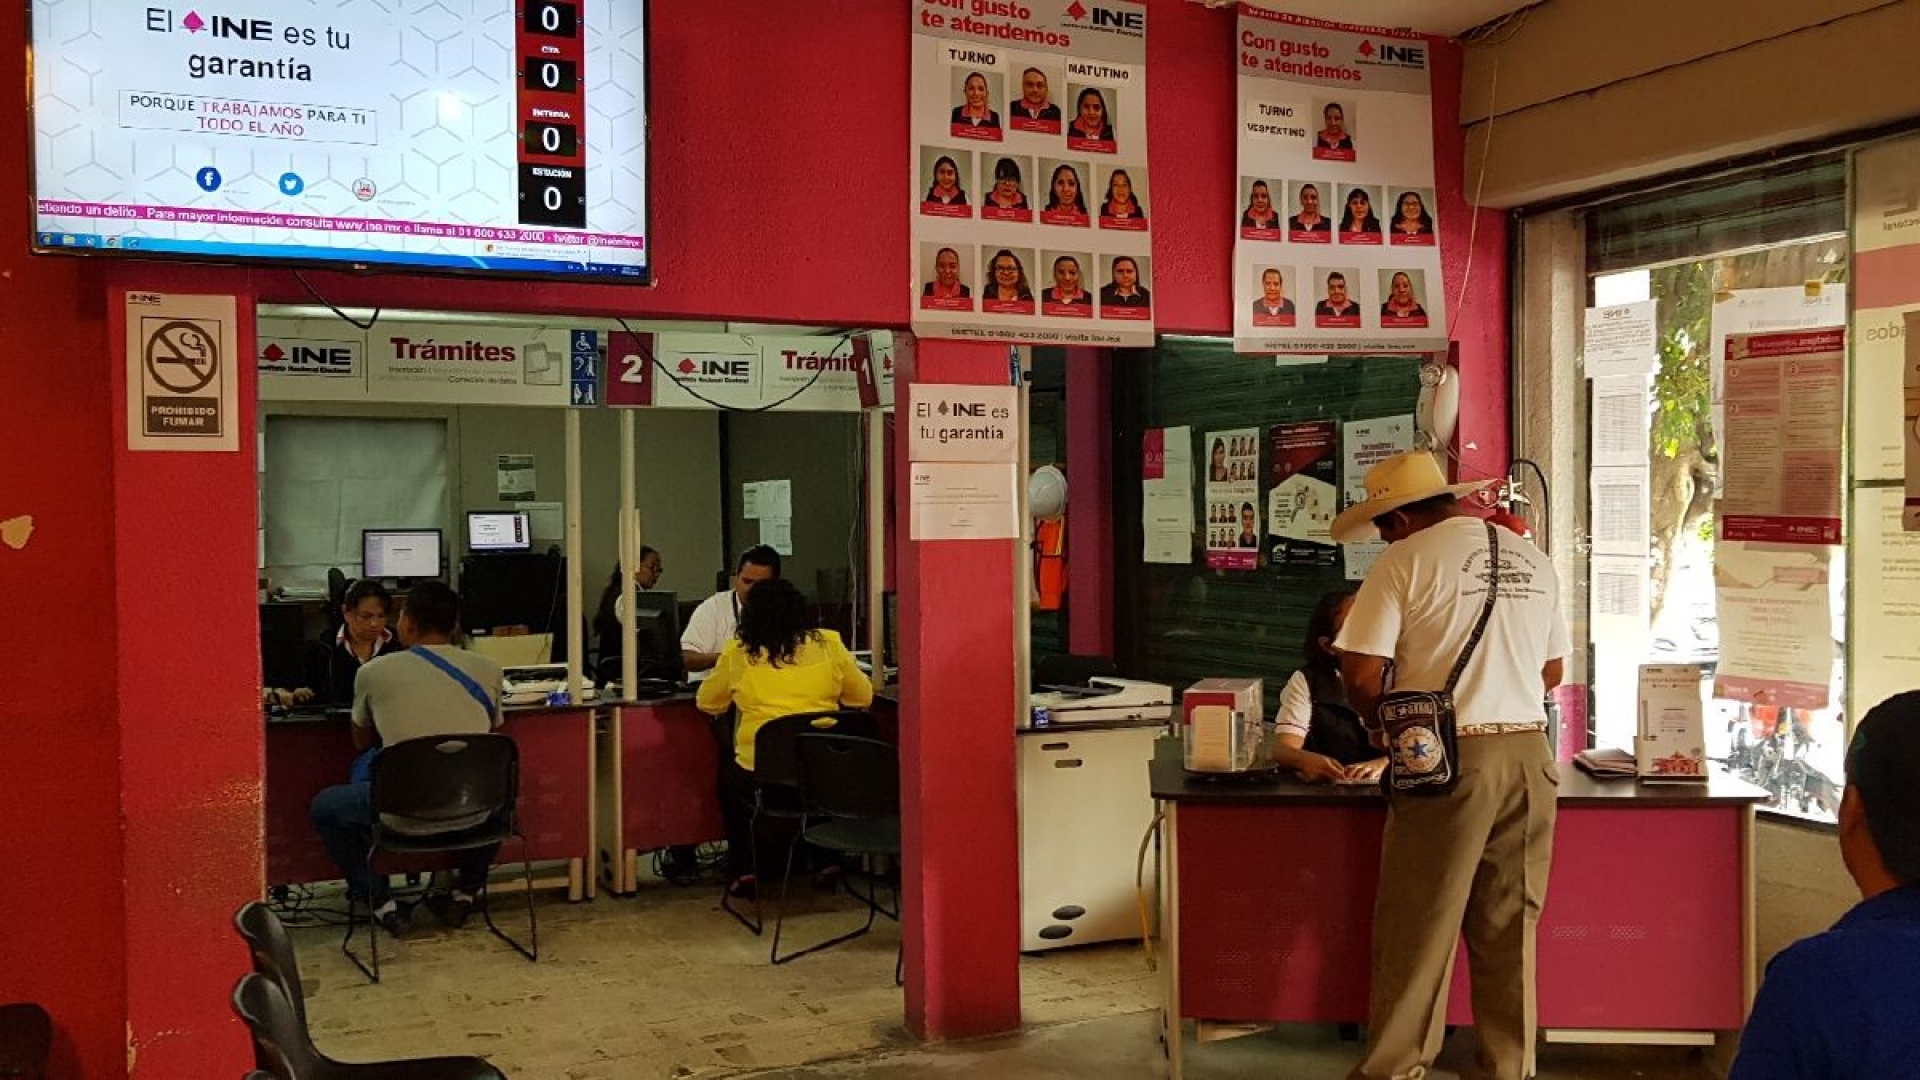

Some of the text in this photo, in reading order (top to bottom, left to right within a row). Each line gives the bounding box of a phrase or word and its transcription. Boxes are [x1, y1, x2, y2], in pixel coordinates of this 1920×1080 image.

[146, 7, 350, 50] El INE es tu
[542, 6, 559, 30] 0
[921, 9, 1070, 47] te atendemos
[1093, 8, 1143, 29] INE
[1242, 30, 1330, 58] Con gusto
[1381, 45, 1424, 63] INE
[189, 54, 312, 81] garantía
[949, 49, 996, 65] TURNO
[1242, 53, 1258, 67] te
[1265, 59, 1361, 81] atendemos
[542, 64, 559, 88] 0
[1069, 63, 1129, 80] MATUTINO
[131, 95, 366, 124] PORQUE TRABAJAMOS PARA TI
[1259, 104, 1293, 117] TURNO
[197, 117, 304, 136] TODO EL AÑO
[543, 127, 560, 151] 0
[544, 186, 562, 210] 0
[86, 206, 100, 214] un
[147, 208, 174, 219] Para
[179, 212, 215, 222] mayor
[520, 231, 544, 242] 2000
[292, 346, 351, 365] INE
[390, 337, 516, 361] Trámites
[620, 354, 643, 383] 2
[702, 361, 749, 376] INE
[862, 358, 871, 385] 1
[151, 406, 216, 415] PROHIBIDO
[163, 417, 204, 426] FUMAR
[917, 403, 1009, 418] El INE es
[921, 426, 935, 438] tu
